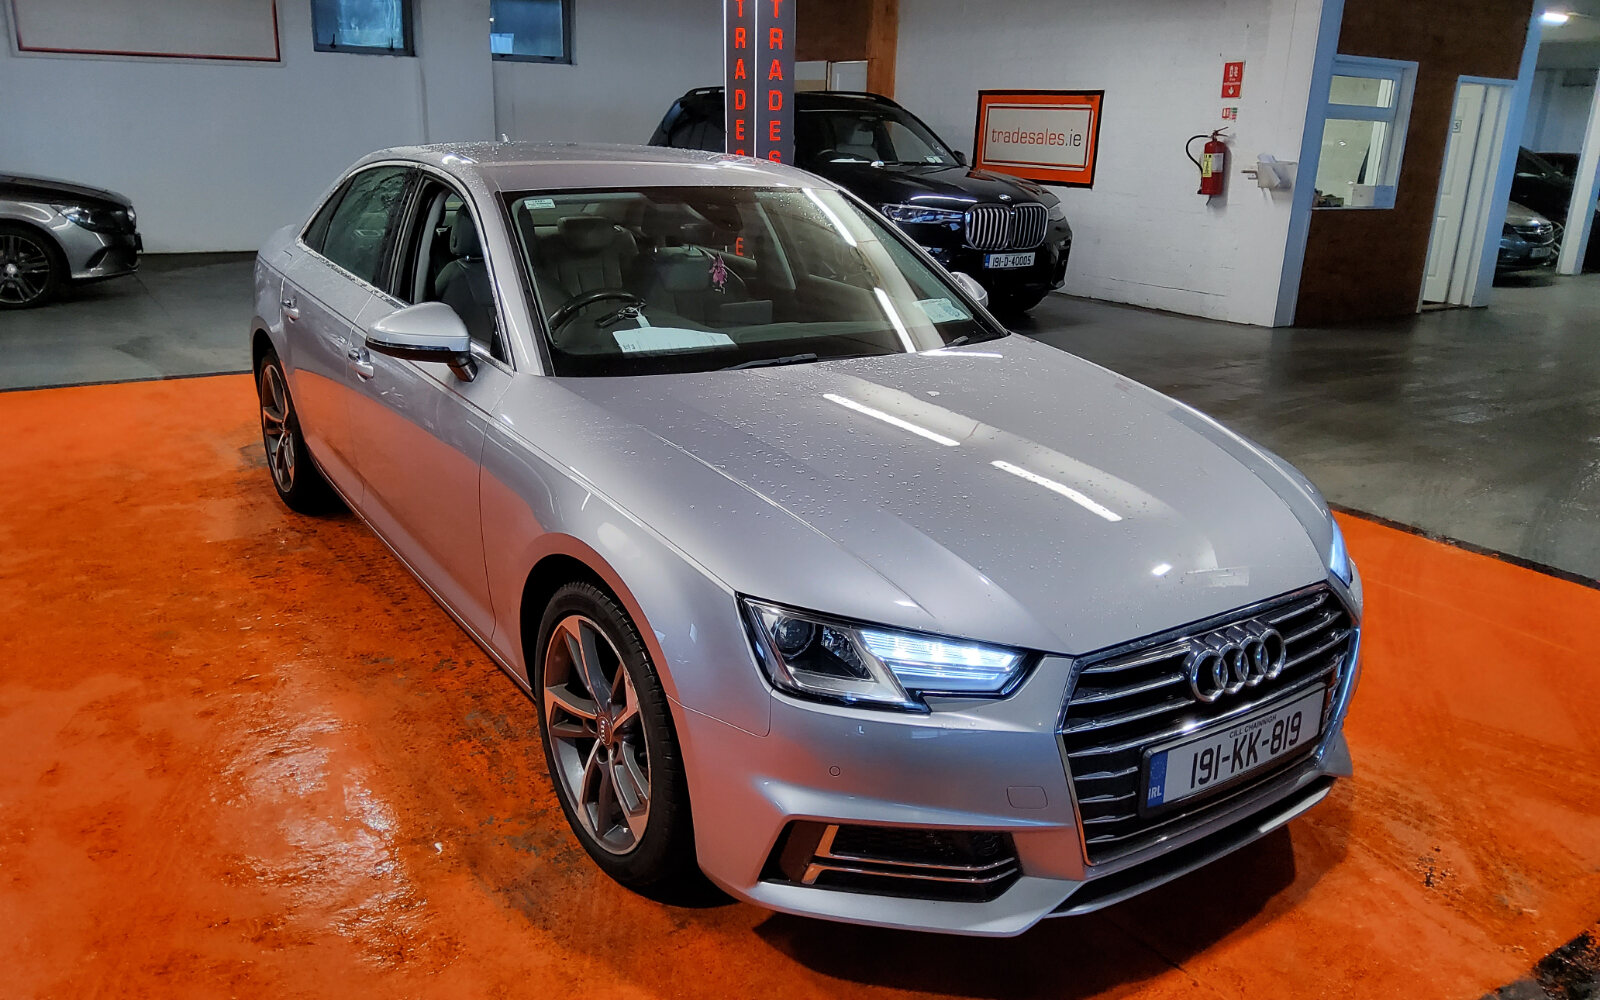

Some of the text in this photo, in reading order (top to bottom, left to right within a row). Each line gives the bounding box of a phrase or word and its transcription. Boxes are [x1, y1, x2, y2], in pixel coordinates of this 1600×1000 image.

[991, 127, 1082, 147] tradesales.ie
[992, 255, 1032, 267] 191-D-40005
[1229, 728, 1243, 739] CILL
[1190, 711, 1302, 789] 191-KK-819
[1148, 785, 1162, 800] IRL
